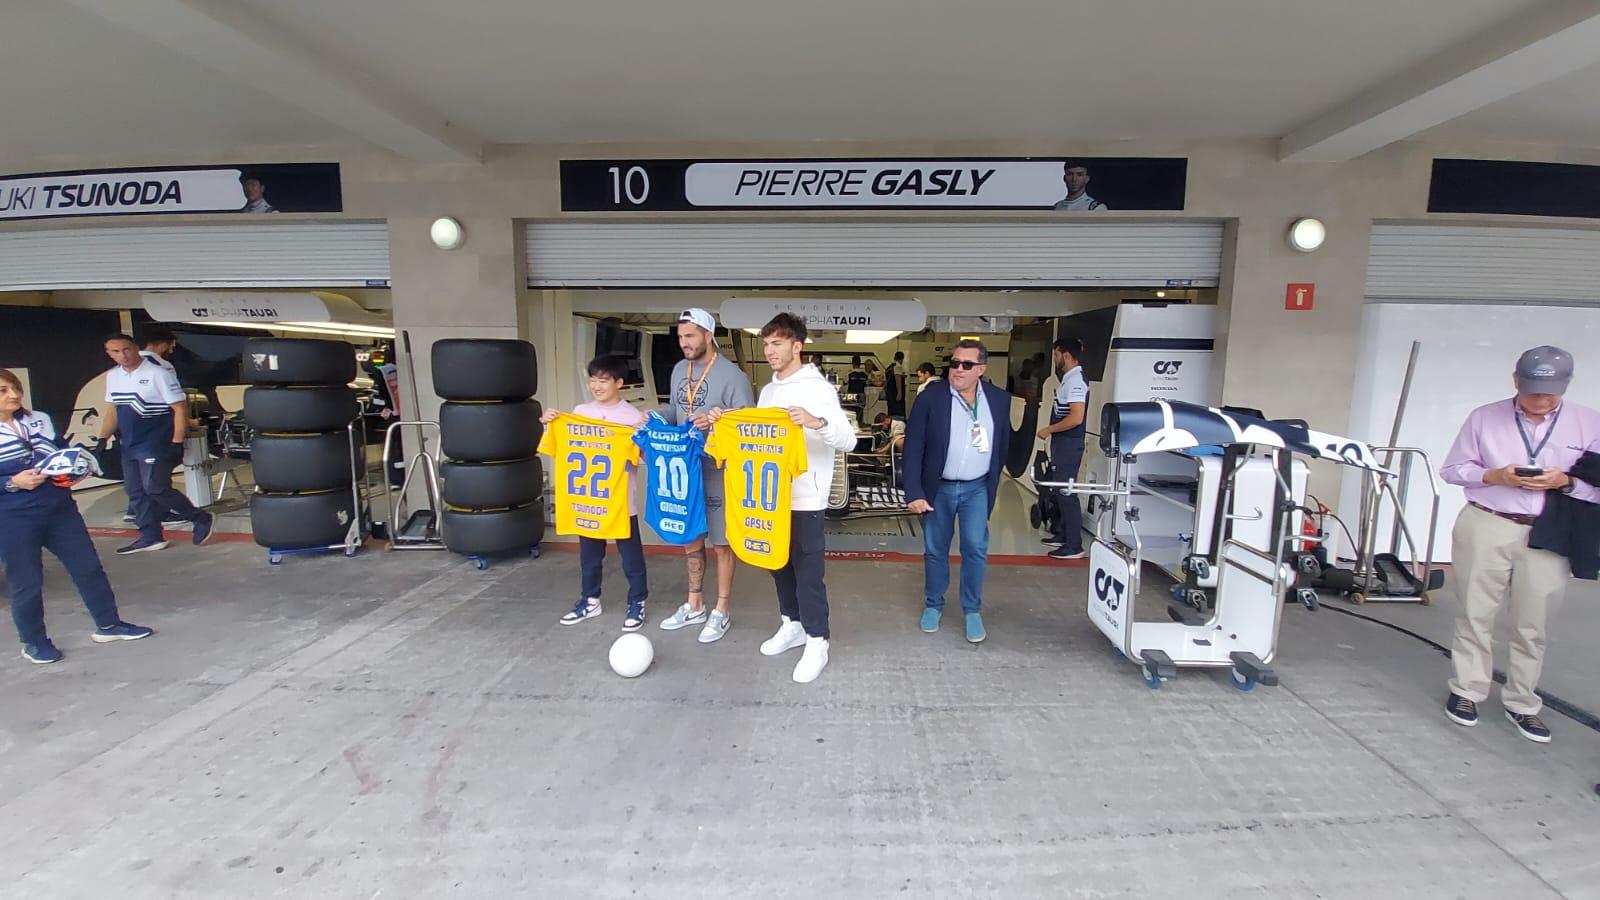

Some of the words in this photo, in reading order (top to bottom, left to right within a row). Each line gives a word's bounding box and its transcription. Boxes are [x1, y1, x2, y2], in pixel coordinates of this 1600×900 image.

[0, 186, 37, 211] UKI
[43, 180, 182, 208] TSUNODA
[608, 166, 650, 204] 10
[735, 170, 867, 196] PIERRE
[871, 169, 996, 196] GASLY
[567, 423, 605, 438] TECATE
[736, 423, 778, 438] TECATE
[567, 451, 611, 499] 22
[655, 455, 689, 500] 10
[742, 460, 779, 512] 10
[745, 516, 772, 531] GASLY
